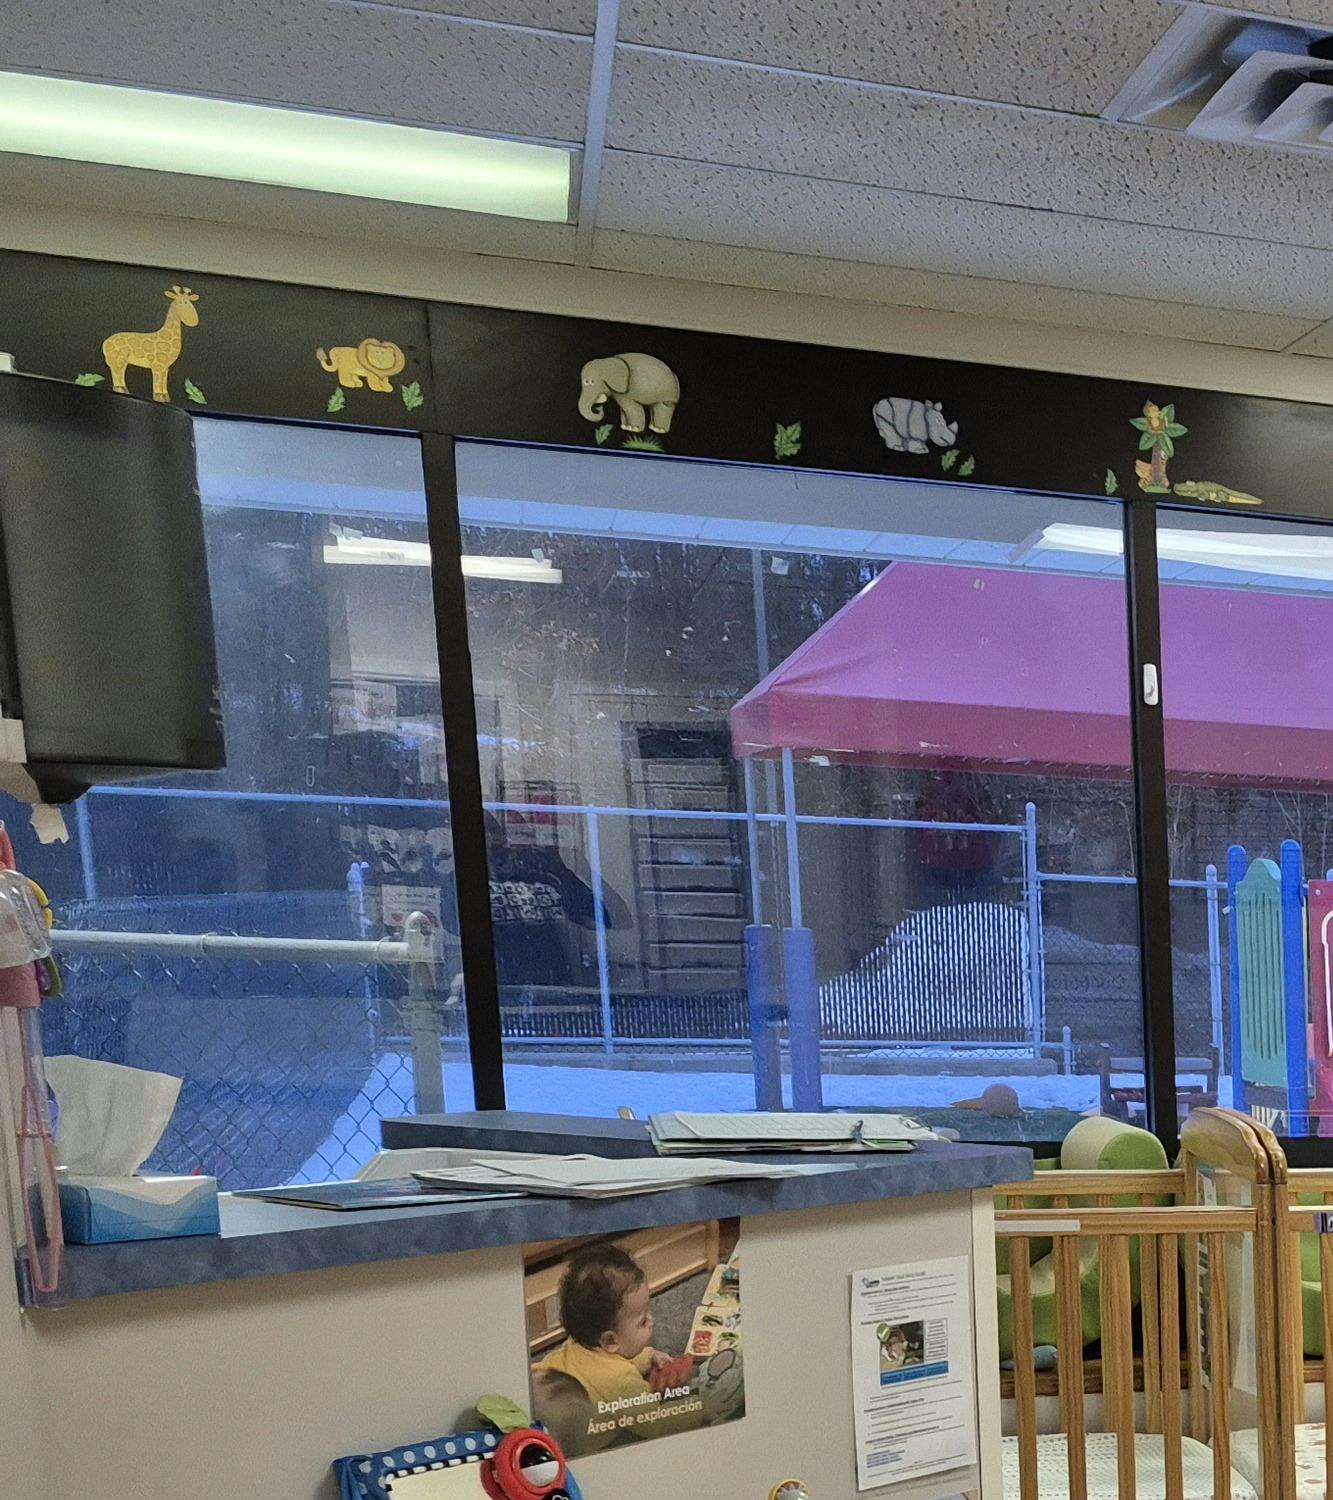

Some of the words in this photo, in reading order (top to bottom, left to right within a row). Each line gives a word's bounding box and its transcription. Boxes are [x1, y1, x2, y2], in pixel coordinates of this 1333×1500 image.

[597, 1391, 662, 1414] Exploration
[664, 1385, 691, 1400] Area
[587, 1418, 616, 1435] Área
[618, 1415, 634, 1428] de
[637, 1399, 703, 1424] exploración
